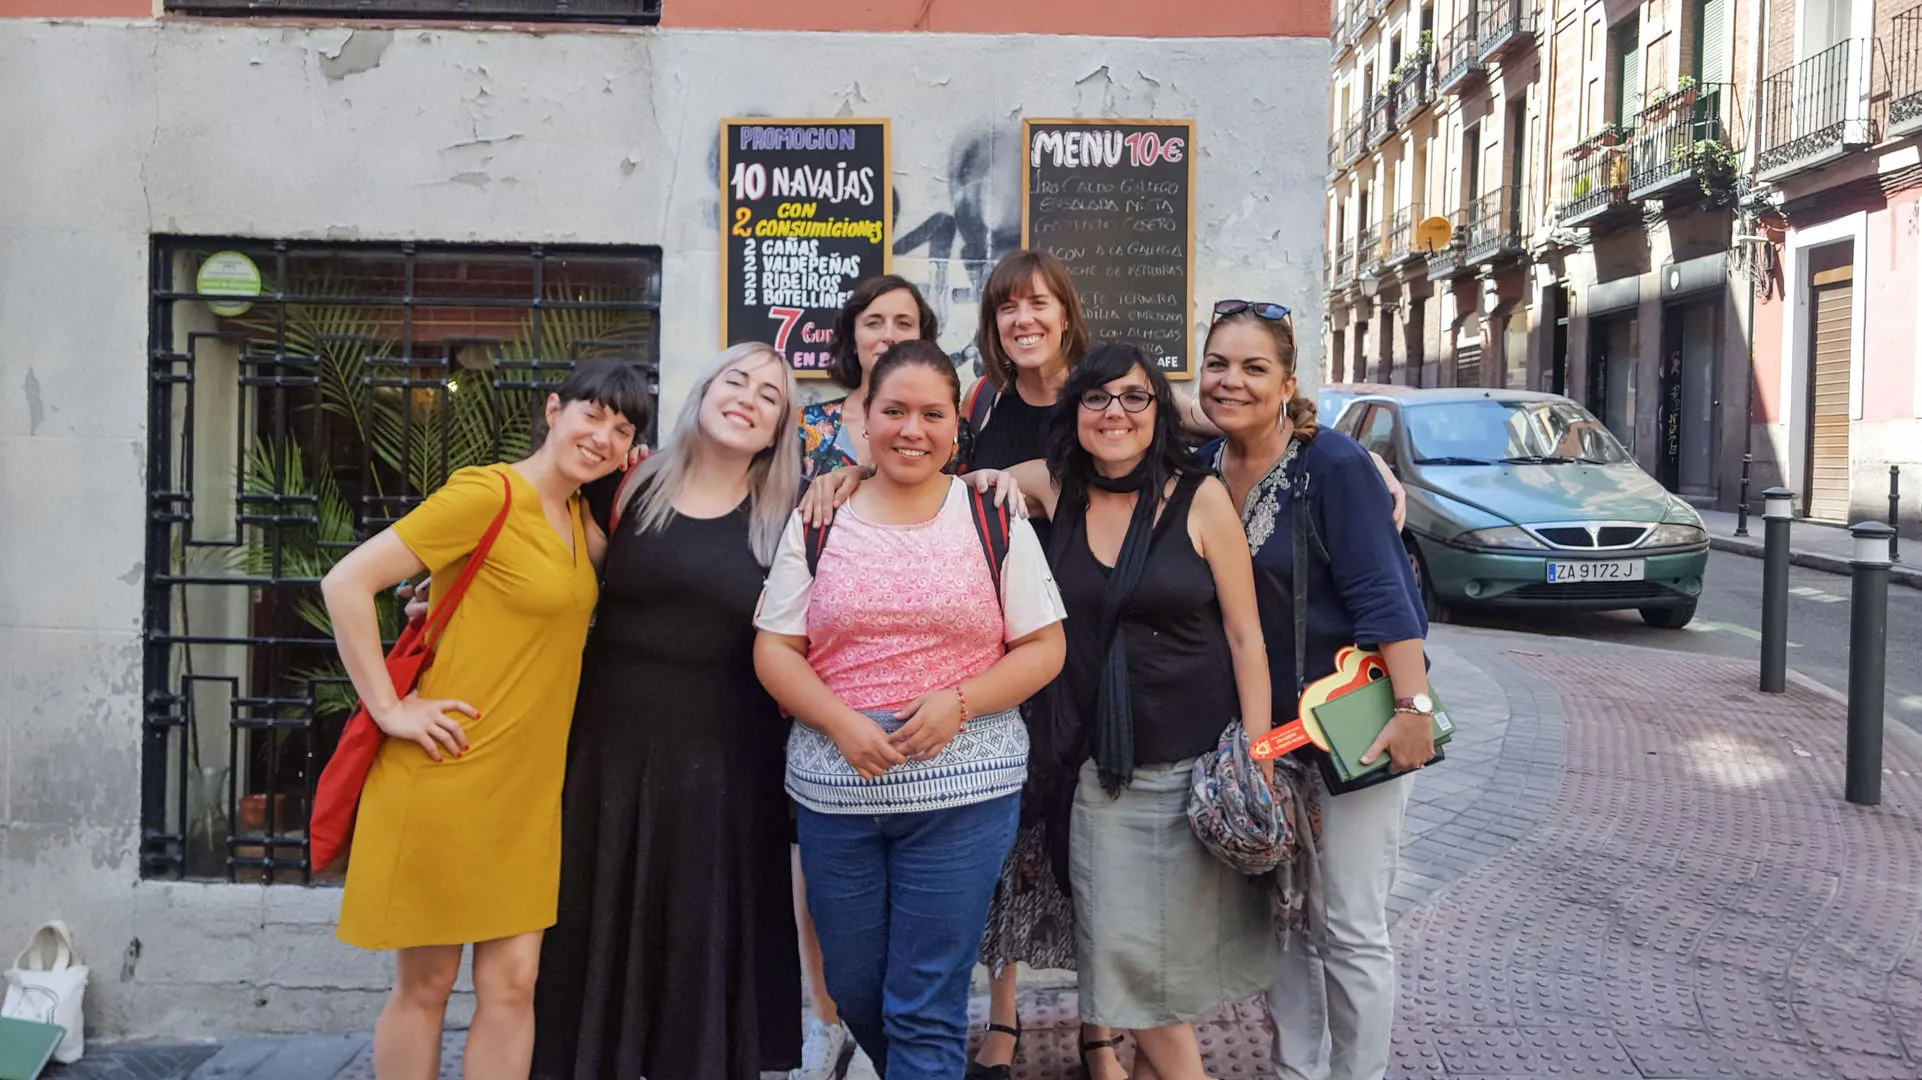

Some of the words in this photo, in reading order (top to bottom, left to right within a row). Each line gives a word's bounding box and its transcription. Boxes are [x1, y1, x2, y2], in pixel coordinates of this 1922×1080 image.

[740, 126, 855, 150] PROMOCION
[1030, 130, 1124, 168] MENU
[1124, 131, 1185, 167] 10€
[730, 162, 767, 200] 10
[732, 206, 752, 237] 2
[776, 202, 817, 219] CON
[743, 237, 757, 256] 2
[761, 236, 820, 258] CAÑAS
[743, 255, 758, 272] 2
[761, 251, 862, 279] VALDEPEÑAS
[743, 272, 758, 289] 2
[743, 289, 758, 306] 2
[768, 305, 805, 352] 7
[793, 351, 815, 368] EN
[1155, 355, 1179, 369] AFE
[1556, 564, 1576, 580] ZA
[1580, 563, 1619, 579] 9172
[1623, 562, 1633, 577] J
